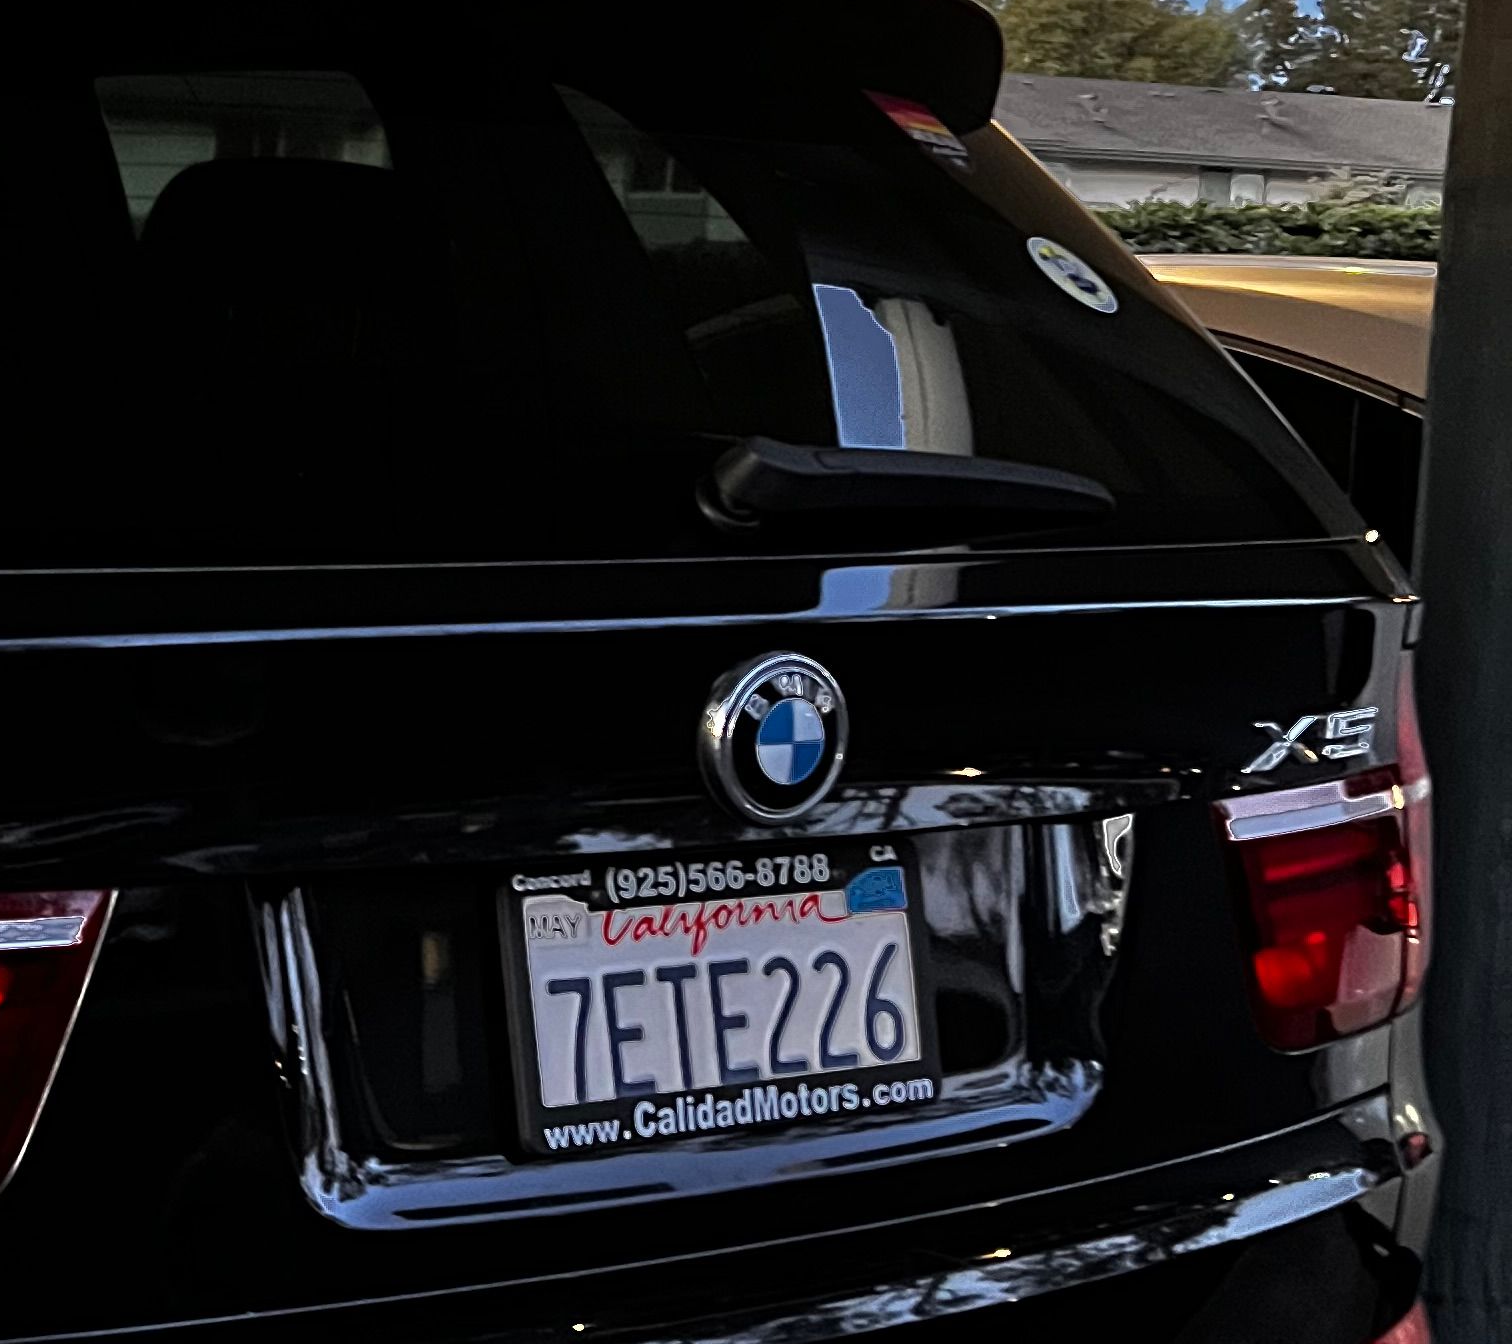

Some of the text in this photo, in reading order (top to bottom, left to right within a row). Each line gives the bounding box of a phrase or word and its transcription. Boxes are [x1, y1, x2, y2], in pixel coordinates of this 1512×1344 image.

[1240, 707, 1379, 774] X5
[512, 869, 592, 892] Concord
[605, 853, 831, 904] (925)566-8788
[869, 844, 899, 862] CA
[528, 913, 582, 940] MAY
[602, 891, 850, 957] California
[545, 943, 906, 1105] 7ETE226
[543, 1077, 935, 1151] www.CalidadMotors.com
